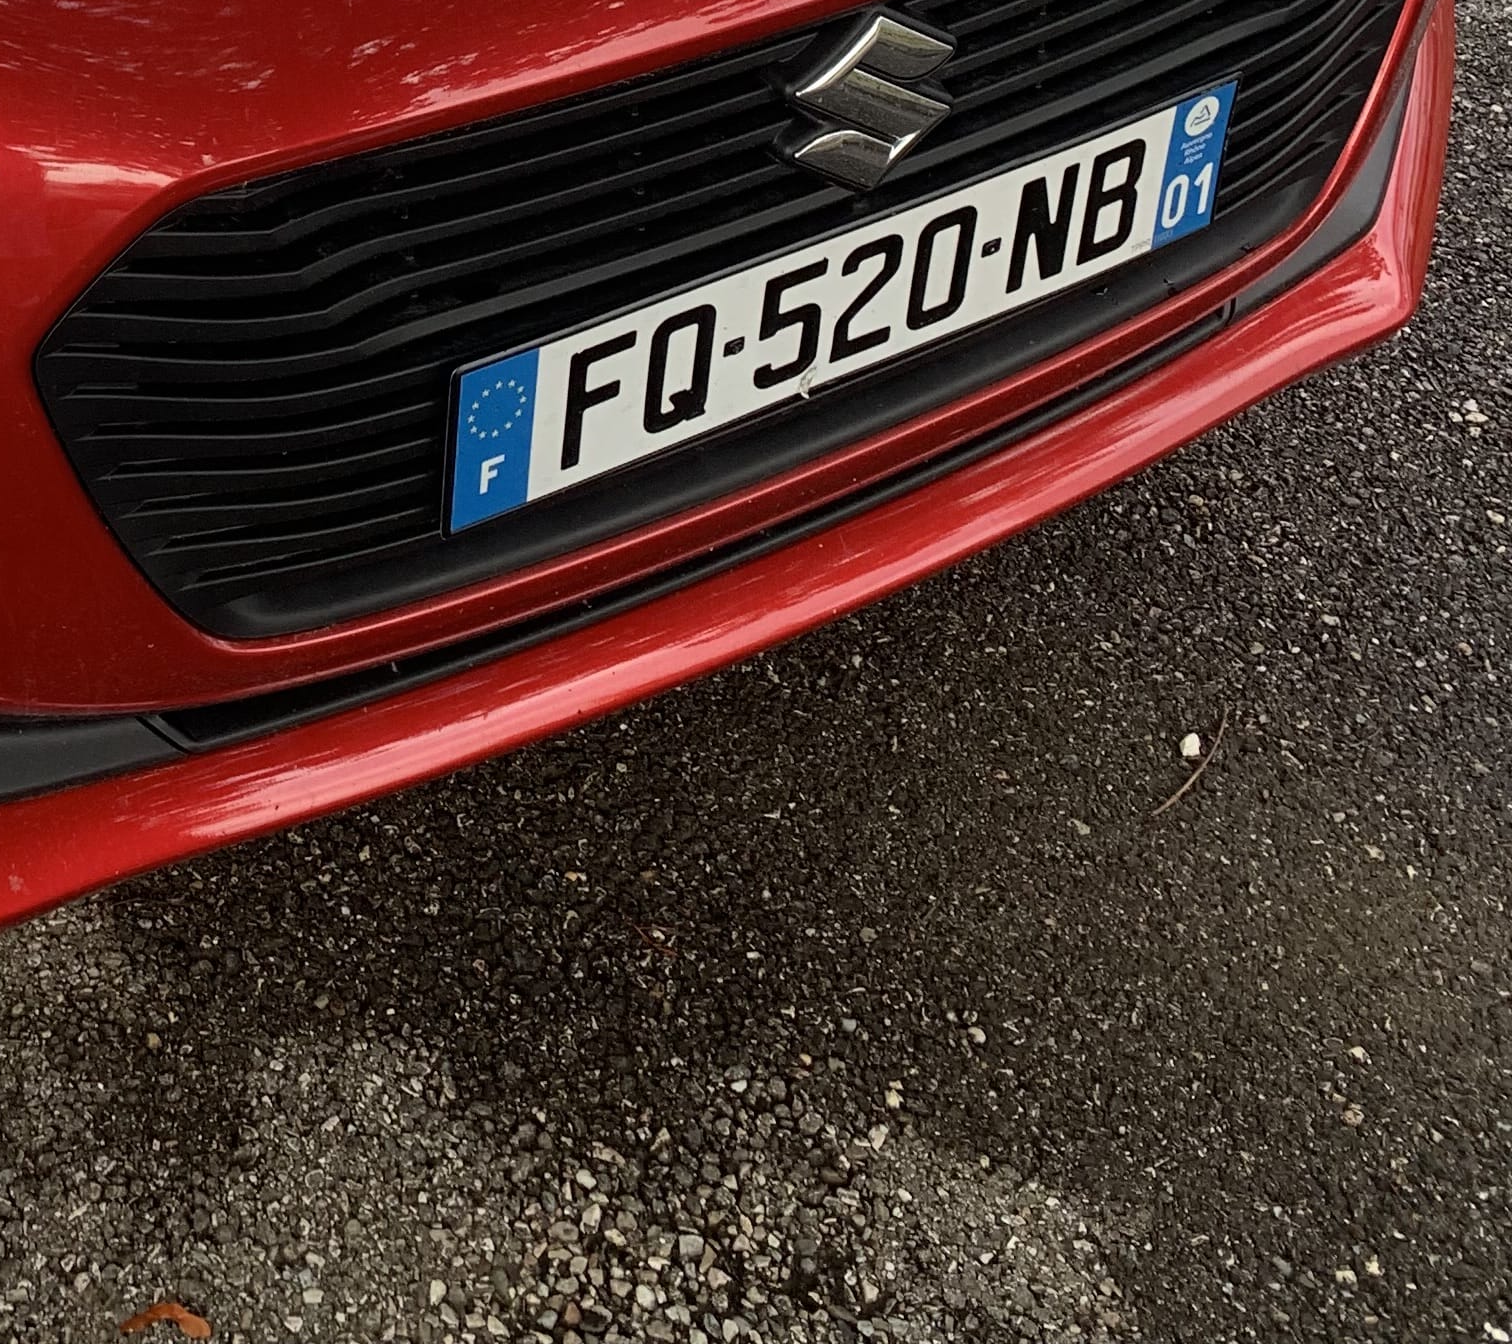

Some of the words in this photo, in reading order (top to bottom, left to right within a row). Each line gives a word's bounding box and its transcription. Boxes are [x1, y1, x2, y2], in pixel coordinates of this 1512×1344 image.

[1161, 162, 1214, 229] 01
[561, 138, 1146, 470] FQ-520-NB
[479, 454, 506, 495] F
